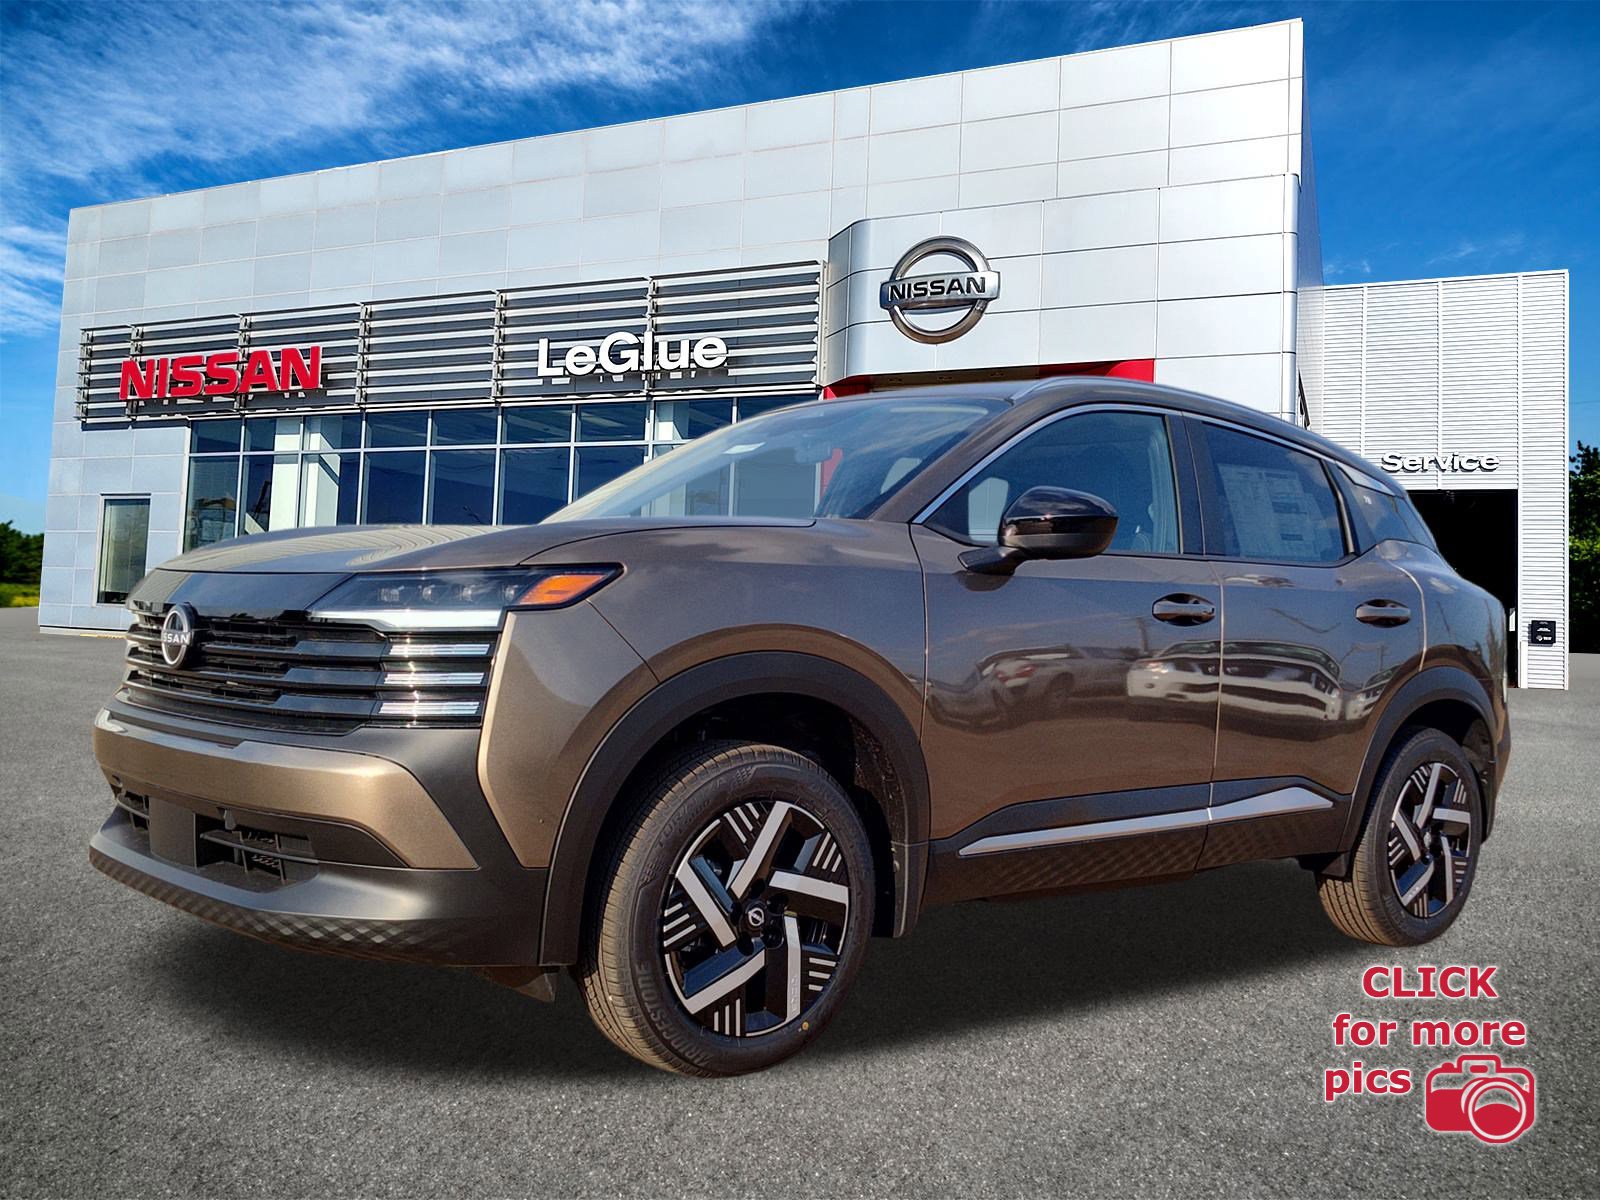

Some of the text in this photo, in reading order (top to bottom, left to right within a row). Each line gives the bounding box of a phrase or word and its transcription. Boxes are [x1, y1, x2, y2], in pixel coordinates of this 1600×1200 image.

[888, 276, 986, 301] NISSAN
[537, 331, 728, 377] LeGlue
[119, 346, 321, 400] NISSAN
[1381, 450, 1499, 473] Service
[162, 632, 190, 645] SSAN
